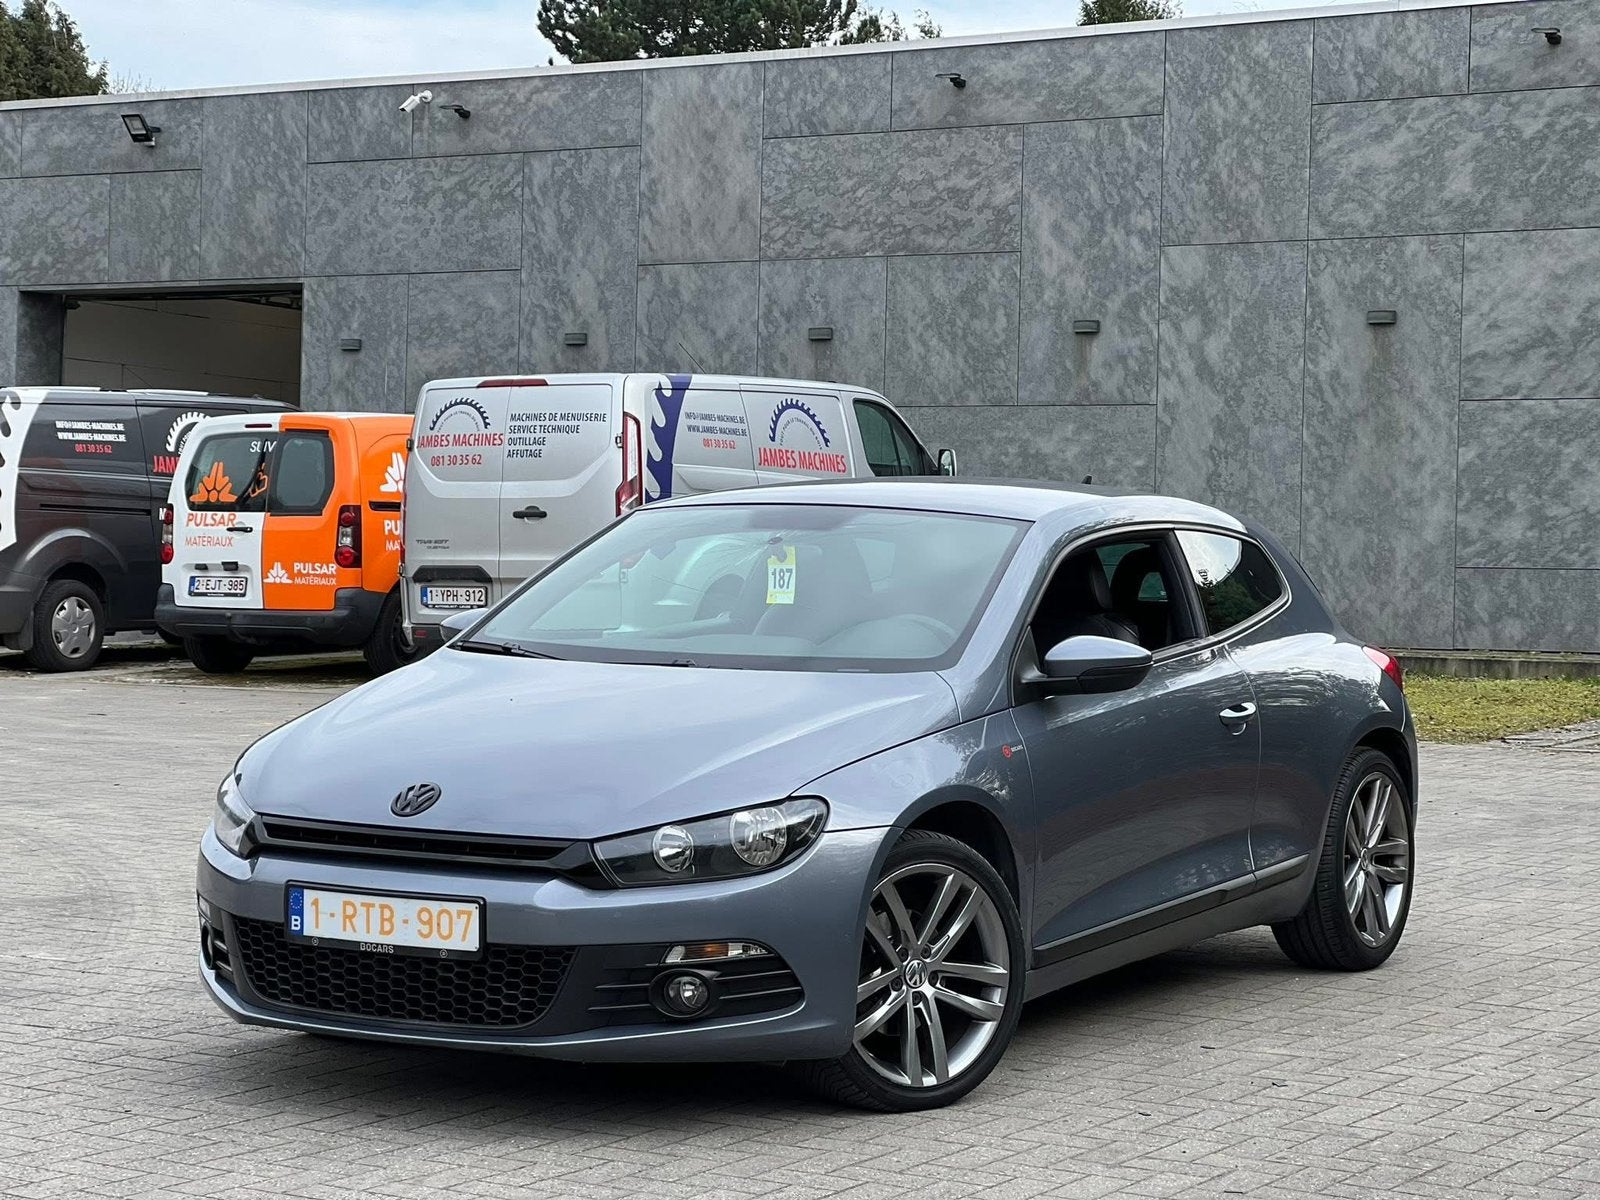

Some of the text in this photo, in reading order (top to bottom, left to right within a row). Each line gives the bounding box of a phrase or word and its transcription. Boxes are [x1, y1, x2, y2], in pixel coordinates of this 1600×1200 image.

[509, 412, 607, 422] MACHINES DE MENUISERIE
[508, 424, 580, 434] SERVICE TECHNIQUE
[417, 433, 504, 449] JAMBES MACHINES
[507, 436, 546, 446] OUTILLAGE
[703, 438, 736, 449] 081 30 35 62
[74, 443, 112, 454] 081 30 35 62
[507, 448, 542, 458] AFFUTAGE
[153, 455, 181, 473] JAM
[431, 453, 482, 466] 081 30 35 62
[758, 447, 846, 473] JAMBES MACHINES
[186, 512, 237, 527] PULSAR
[185, 533, 234, 547] MATÉRIAUX
[293, 562, 337, 575] PULSAR
[294, 575, 337, 586] MATÉRIAUX
[771, 568, 793, 589] 187
[290, 897, 473, 942] B 1-RTB-907
[360, 942, 394, 954] BOCARS
